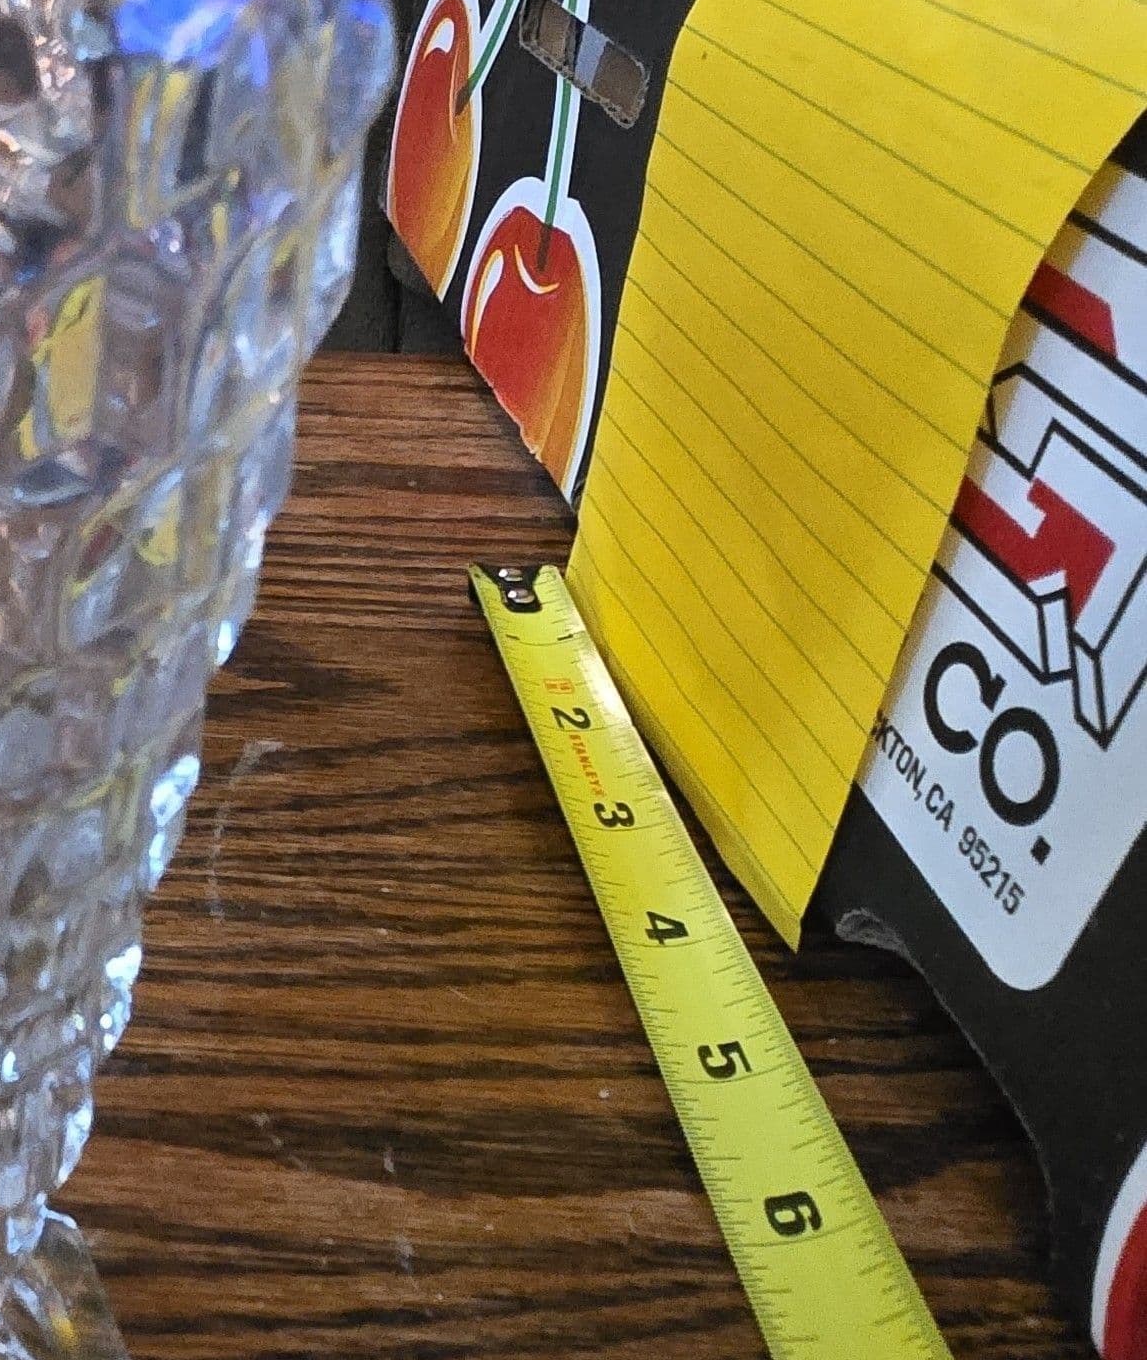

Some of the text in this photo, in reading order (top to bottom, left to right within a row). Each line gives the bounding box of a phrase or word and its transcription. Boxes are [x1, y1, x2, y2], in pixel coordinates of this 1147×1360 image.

[551, 706, 591, 730] 2
[923, 641, 1061, 866] CO.
[593, 801, 635, 829] 3
[925, 783, 955, 832] CA
[958, 826, 1025, 915] 95215
[645, 911, 689, 945] 4
[697, 1040, 752, 1080] 5
[764, 1190, 823, 1237] 6
